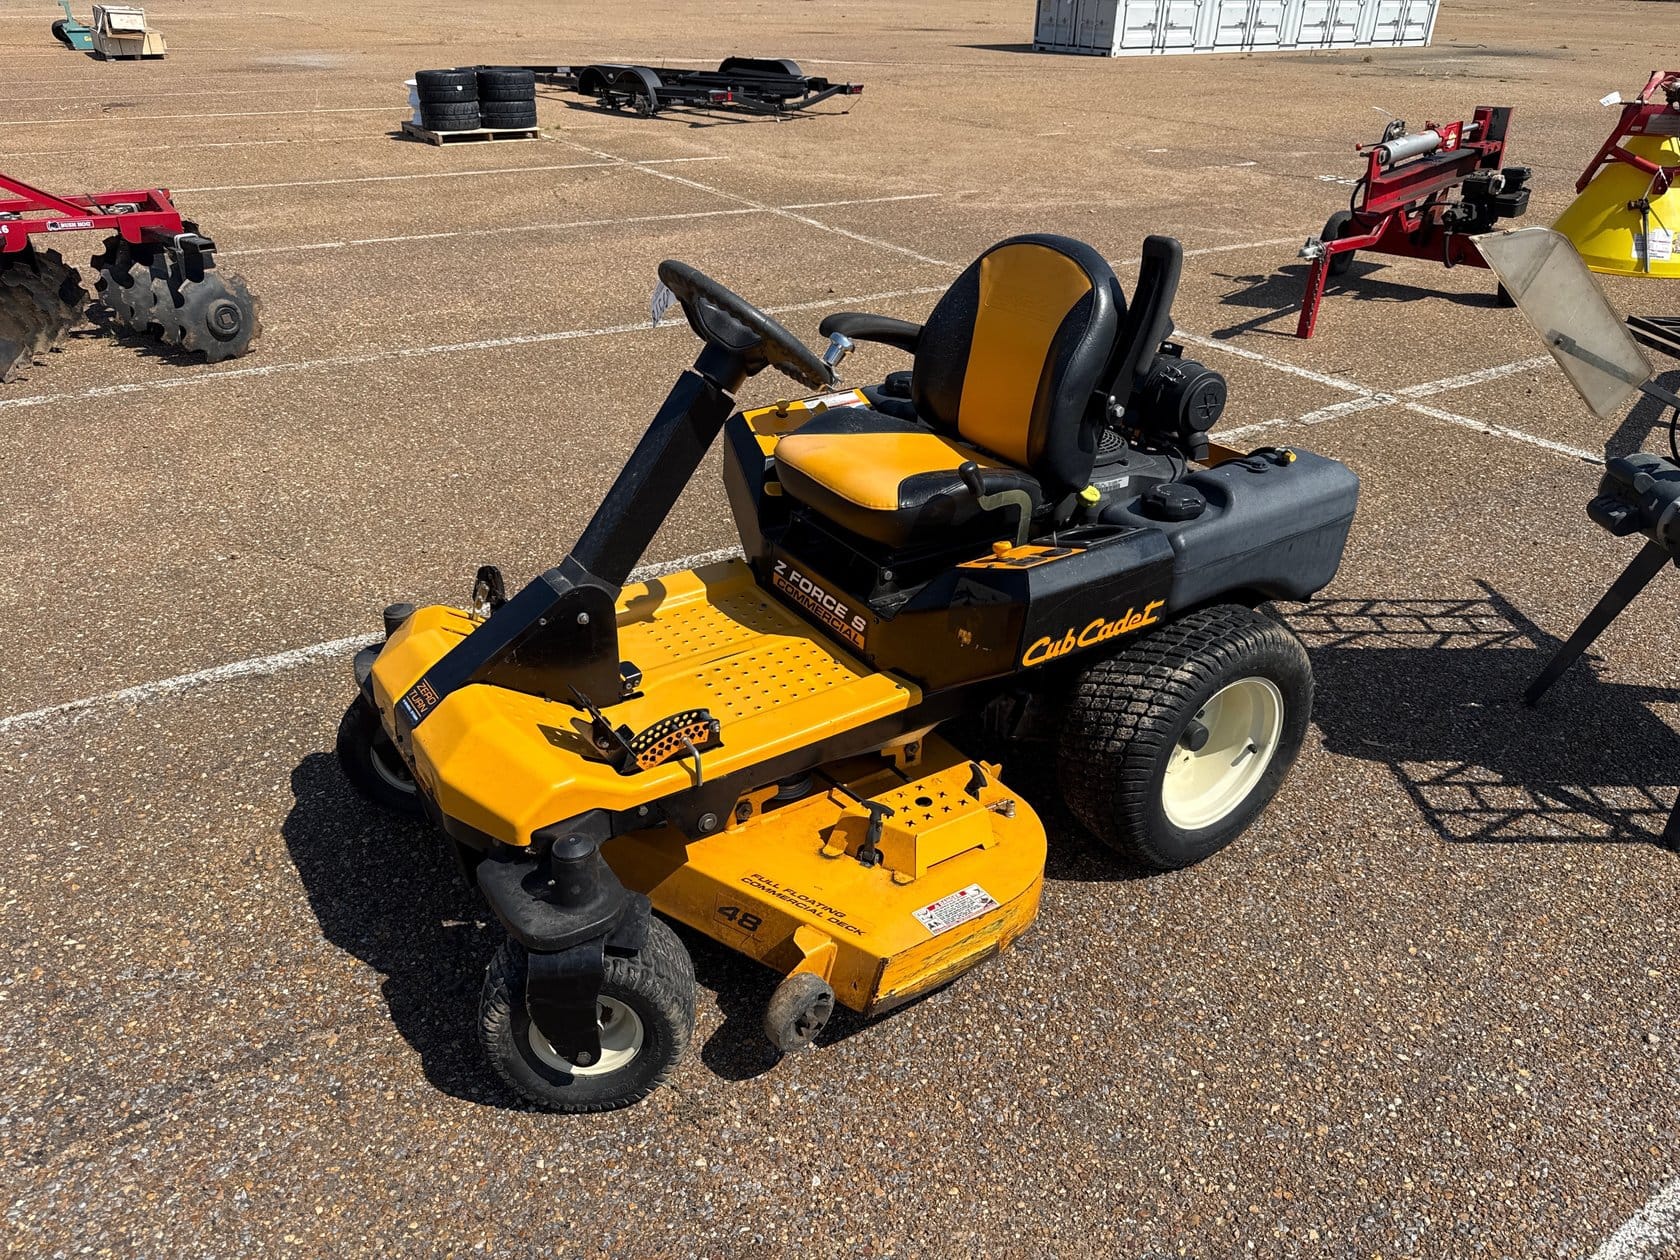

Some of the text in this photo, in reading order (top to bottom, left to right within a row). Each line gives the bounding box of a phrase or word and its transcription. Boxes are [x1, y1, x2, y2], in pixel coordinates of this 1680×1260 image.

[774, 560, 867, 632] Z FORCE S
[777, 578, 860, 645] COMMERCIAL
[1022, 599, 1165, 667] Cub Cadet
[409, 689, 429, 713] TURN
[416, 682, 437, 705] ZERO
[717, 906, 763, 932] 48
[741, 877, 867, 936] COMMERCIAL DECK
[751, 873, 847, 918] FULL FLOATING
